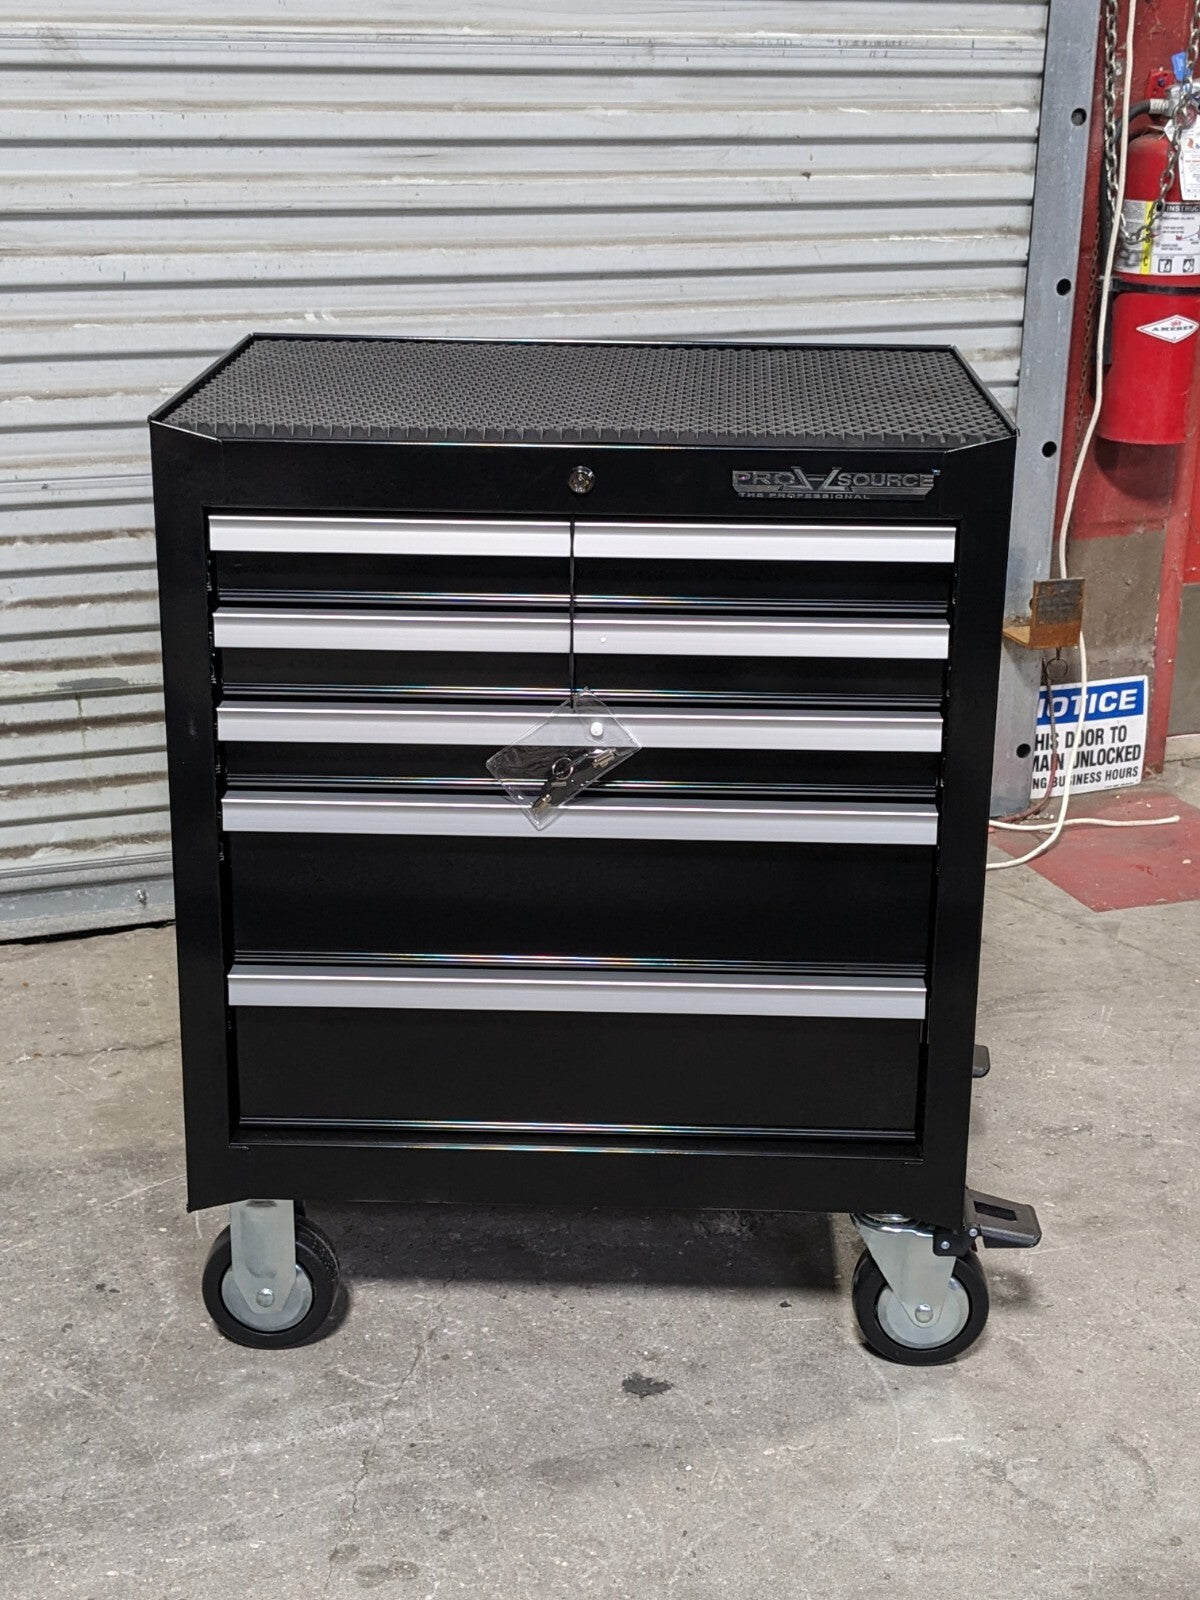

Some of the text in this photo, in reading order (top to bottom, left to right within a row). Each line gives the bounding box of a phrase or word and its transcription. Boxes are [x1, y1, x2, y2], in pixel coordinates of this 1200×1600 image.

[837, 473, 934, 488] SOURCE
[769, 492, 871, 500] PROFESSIONAL
[1110, 725, 1127, 743] TO
[1052, 771, 1102, 788] BUINESS
[1105, 766, 1139, 781] HOURS
